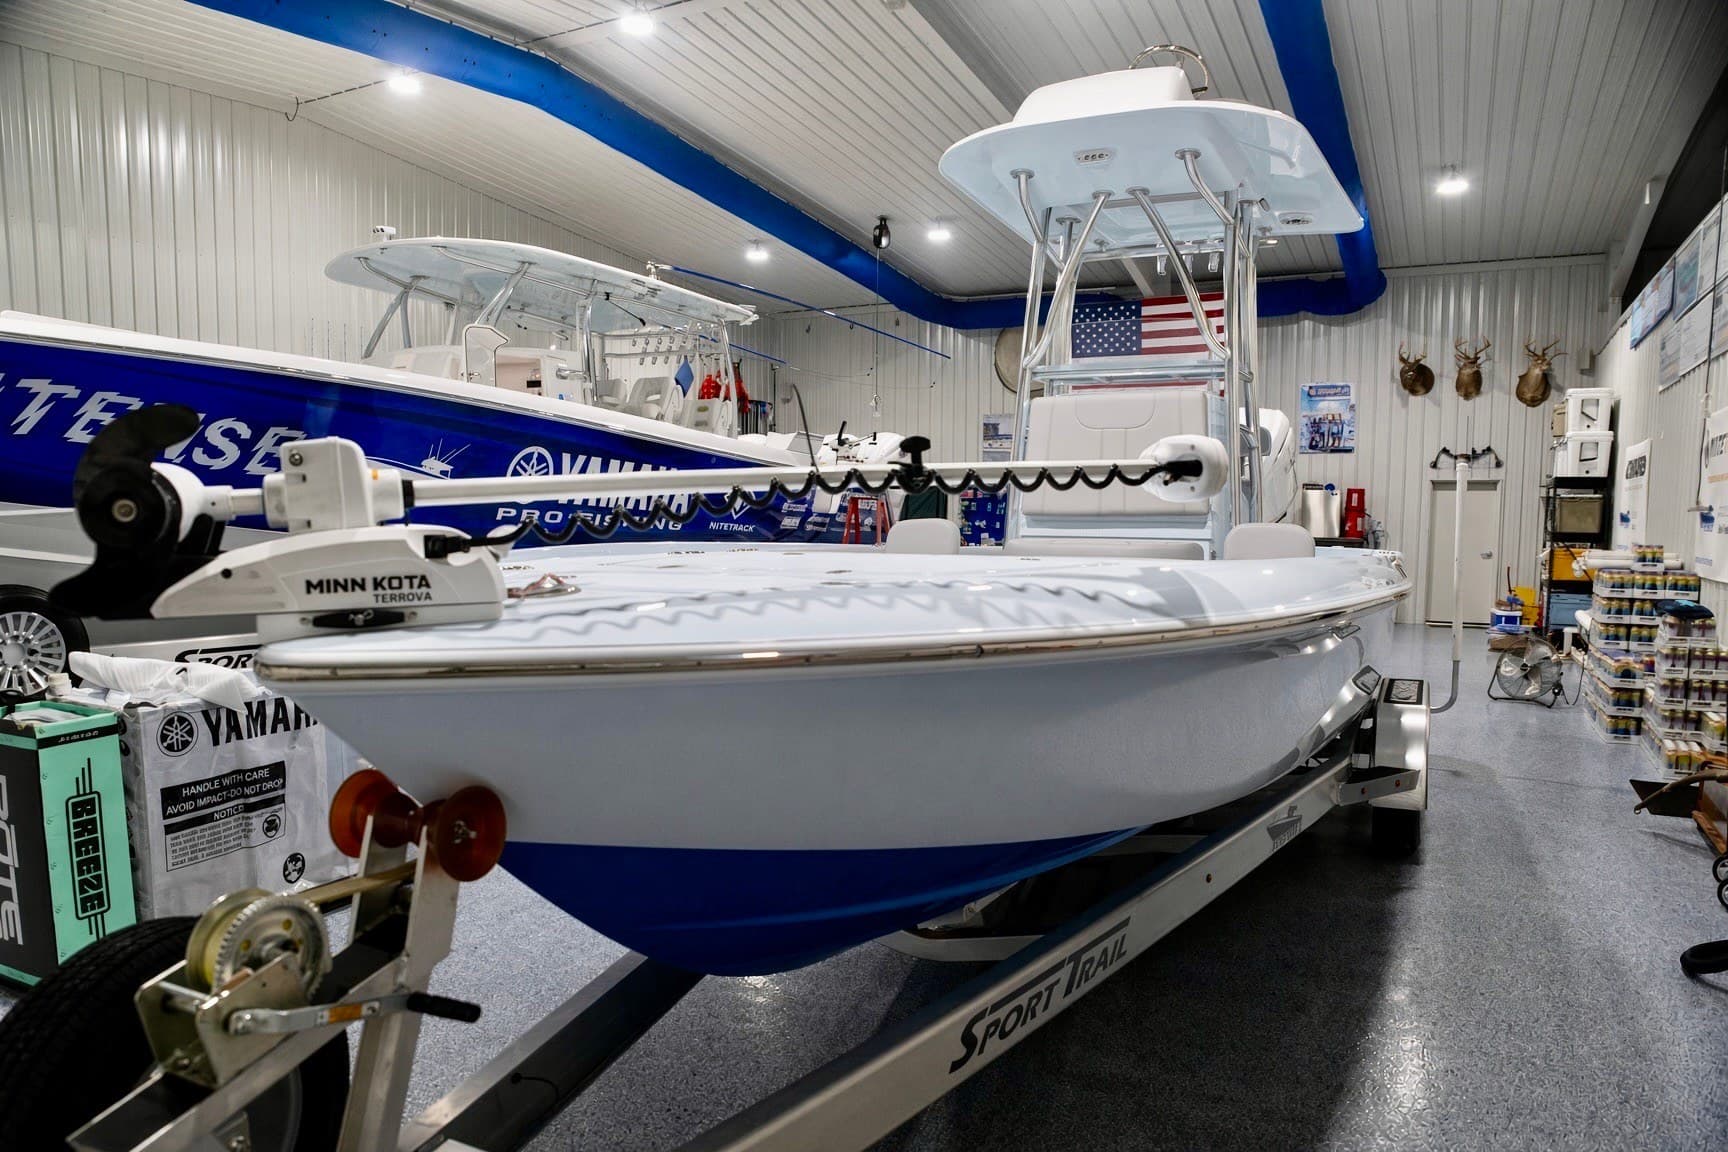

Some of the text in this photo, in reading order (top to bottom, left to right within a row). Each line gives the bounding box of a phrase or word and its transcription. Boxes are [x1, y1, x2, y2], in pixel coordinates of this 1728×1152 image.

[0, 372, 307, 475] TESE
[496, 507, 683, 531] PRO FISNG
[708, 521, 756, 533] NITETRACK
[305, 574, 432, 594] MINN KOTA
[373, 592, 433, 604] TERROVA
[174, 645, 260, 676] SOR
[201, 696, 319, 747] YAMAH
[166, 801, 196, 816] AVOID
[243, 784, 260, 796] NOT
[262, 777, 284, 791] DROP
[182, 768, 271, 798] HANDLE WITH CARE
[213, 805, 245, 821] NOTICE
[71, 796, 107, 915] BREEZE
[949, 916, 1131, 1074] SPORT TRAIL
